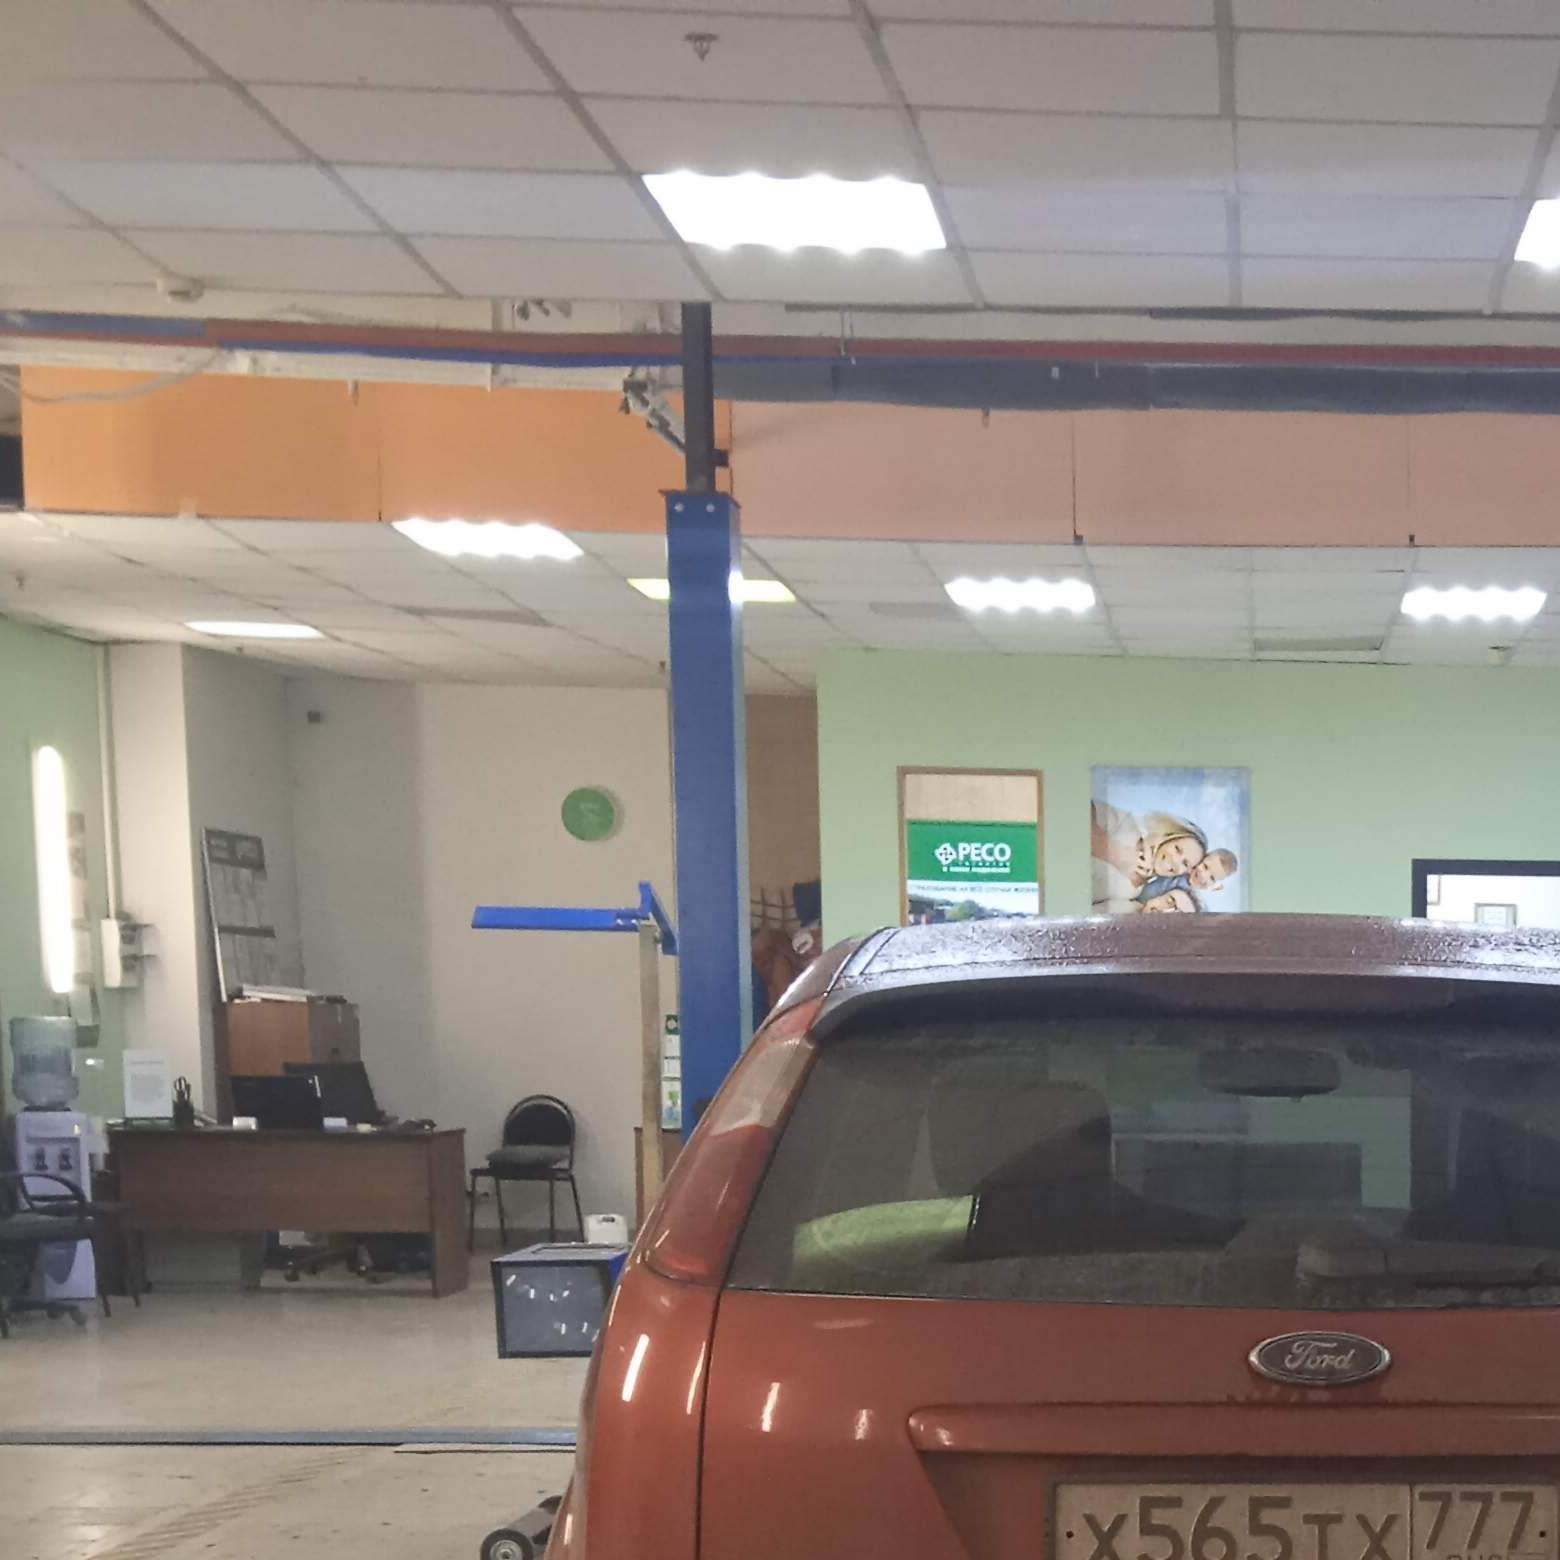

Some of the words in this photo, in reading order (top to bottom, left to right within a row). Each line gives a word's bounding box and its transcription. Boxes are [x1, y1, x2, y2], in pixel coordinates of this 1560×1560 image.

[957, 842, 1012, 862] РЕСО
[1283, 1340, 1356, 1371] Ford
[1417, 1490, 1535, 1551] 777
